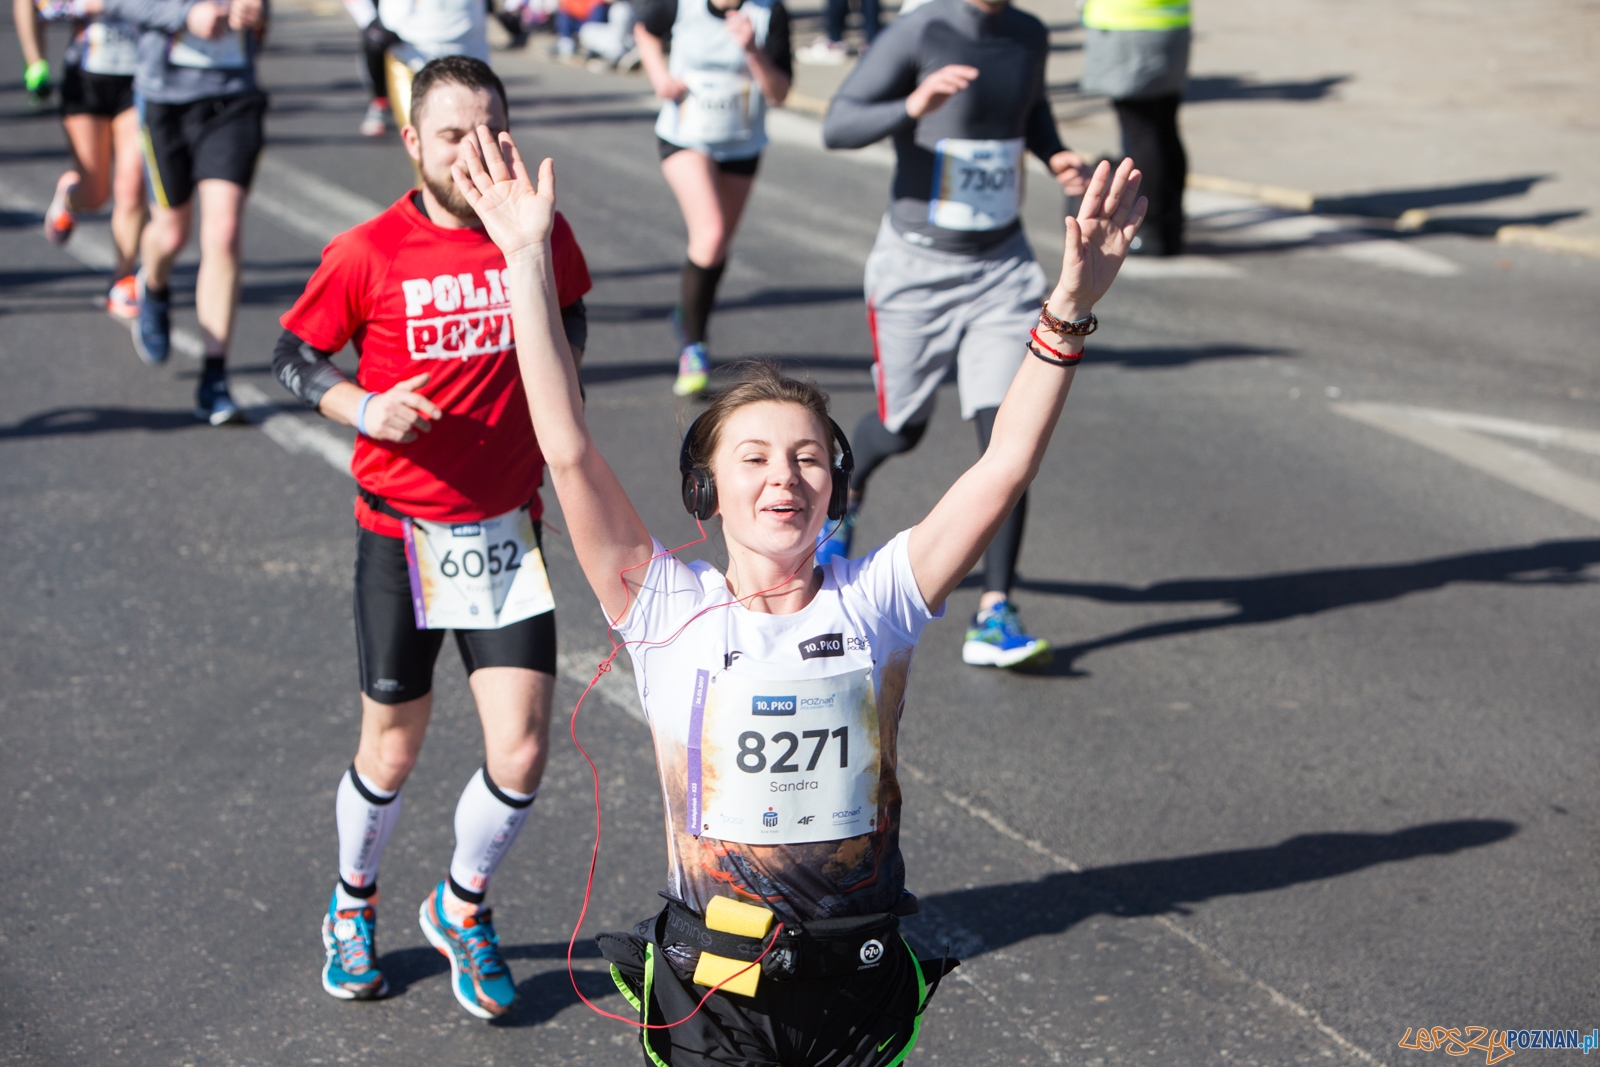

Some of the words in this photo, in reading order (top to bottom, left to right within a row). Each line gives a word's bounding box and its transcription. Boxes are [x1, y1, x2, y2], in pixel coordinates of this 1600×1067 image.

[409, 313, 515, 354] POW
[440, 538, 522, 578] 6052
[736, 726, 849, 774] 8271
[769, 779, 819, 793] Sandra
[797, 815, 816, 825] 4F
[865, 946, 879, 959] PZU
